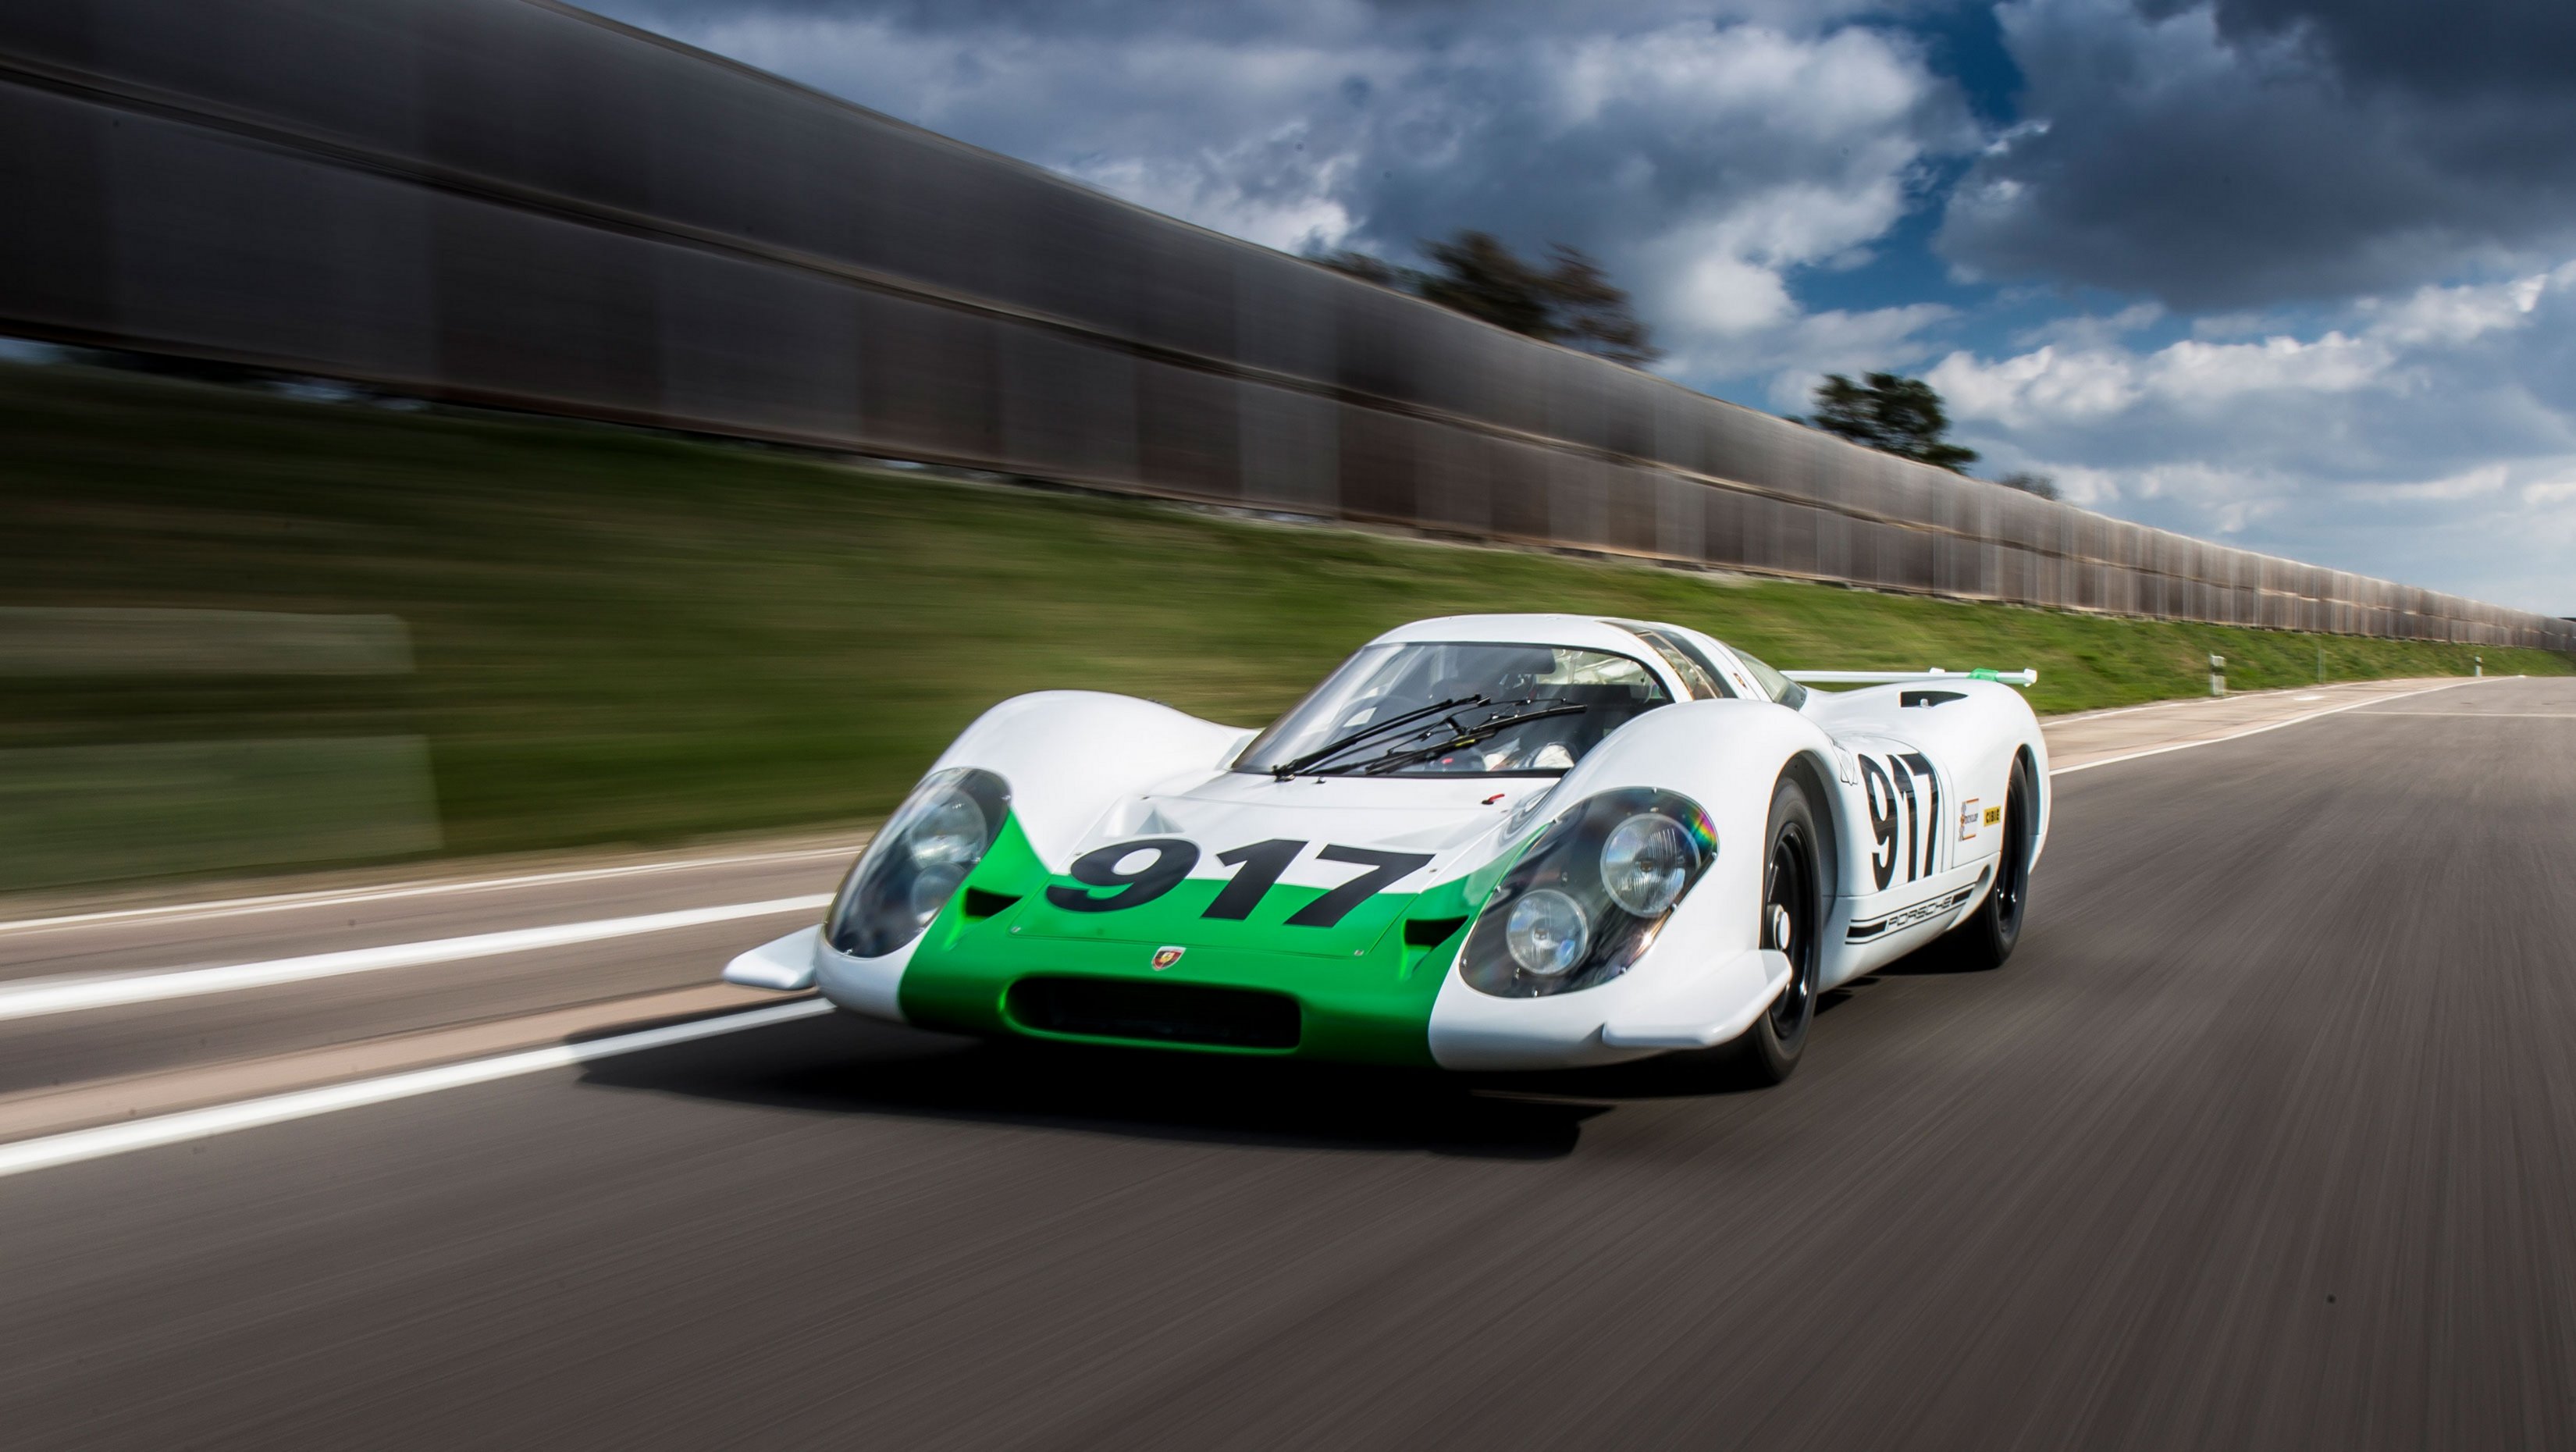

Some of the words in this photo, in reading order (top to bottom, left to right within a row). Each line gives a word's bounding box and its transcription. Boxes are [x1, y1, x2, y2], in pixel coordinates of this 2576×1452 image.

[1858, 753, 1939, 891] 917
[1045, 838, 1436, 927] 917
[1888, 896, 1952, 927] PORSCHE
